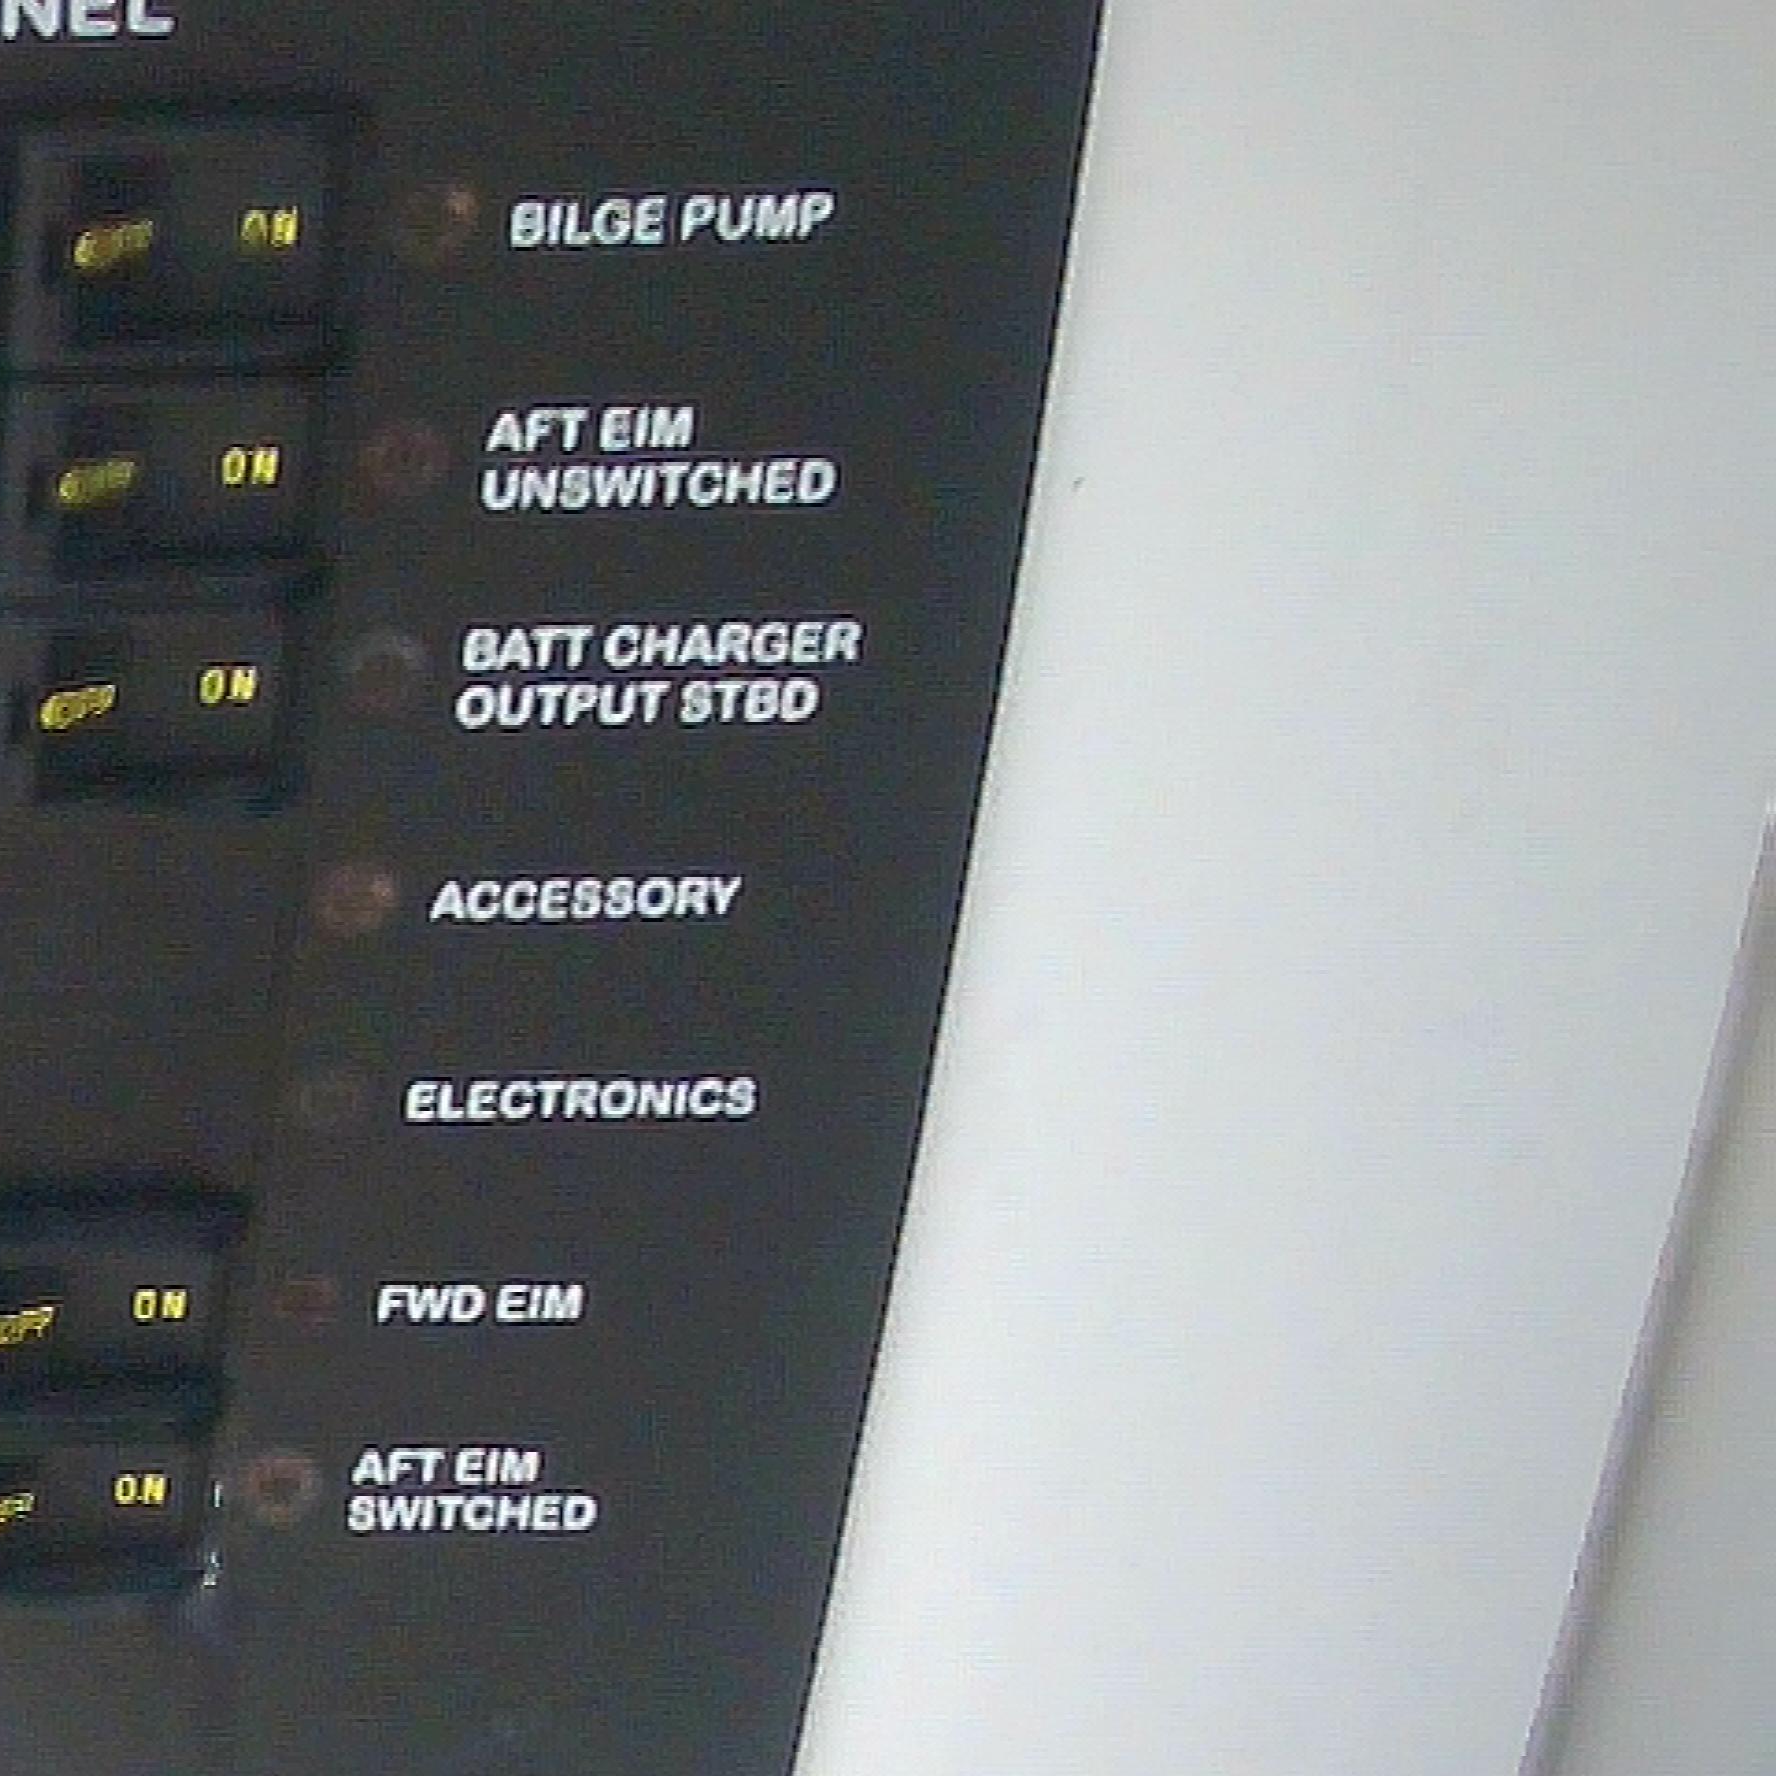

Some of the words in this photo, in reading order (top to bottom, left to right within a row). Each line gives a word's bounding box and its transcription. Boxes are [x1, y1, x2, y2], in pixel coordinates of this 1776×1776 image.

[242, 206, 297, 247] ON
[511, 199, 665, 247] BILGE
[682, 192, 833, 240] PUMP
[487, 410, 587, 451] AFT
[600, 407, 692, 451] EIM
[223, 447, 278, 484] ON
[483, 458, 834, 510] UNSWITCHED
[464, 625, 593, 670] BATT
[604, 622, 860, 666] CHARGER
[201, 666, 256, 703] ON
[457, 681, 670, 729] OUTPUT
[681, 677, 818, 722] STBD
[431, 877, 741, 922] ACCESSORY
[407, 1077, 755, 1122] ELECTRONICS
[134, 1289, 186, 1318] ON
[378, 1285, 485, 1322] FWD
[497, 1285, 582, 1322] EIM
[353, 1448, 444, 1485] AFT
[455, 1448, 539, 1485] EIM
[116, 1474, 165, 1504] ON
[349, 1496, 596, 1530] SWITCHED
